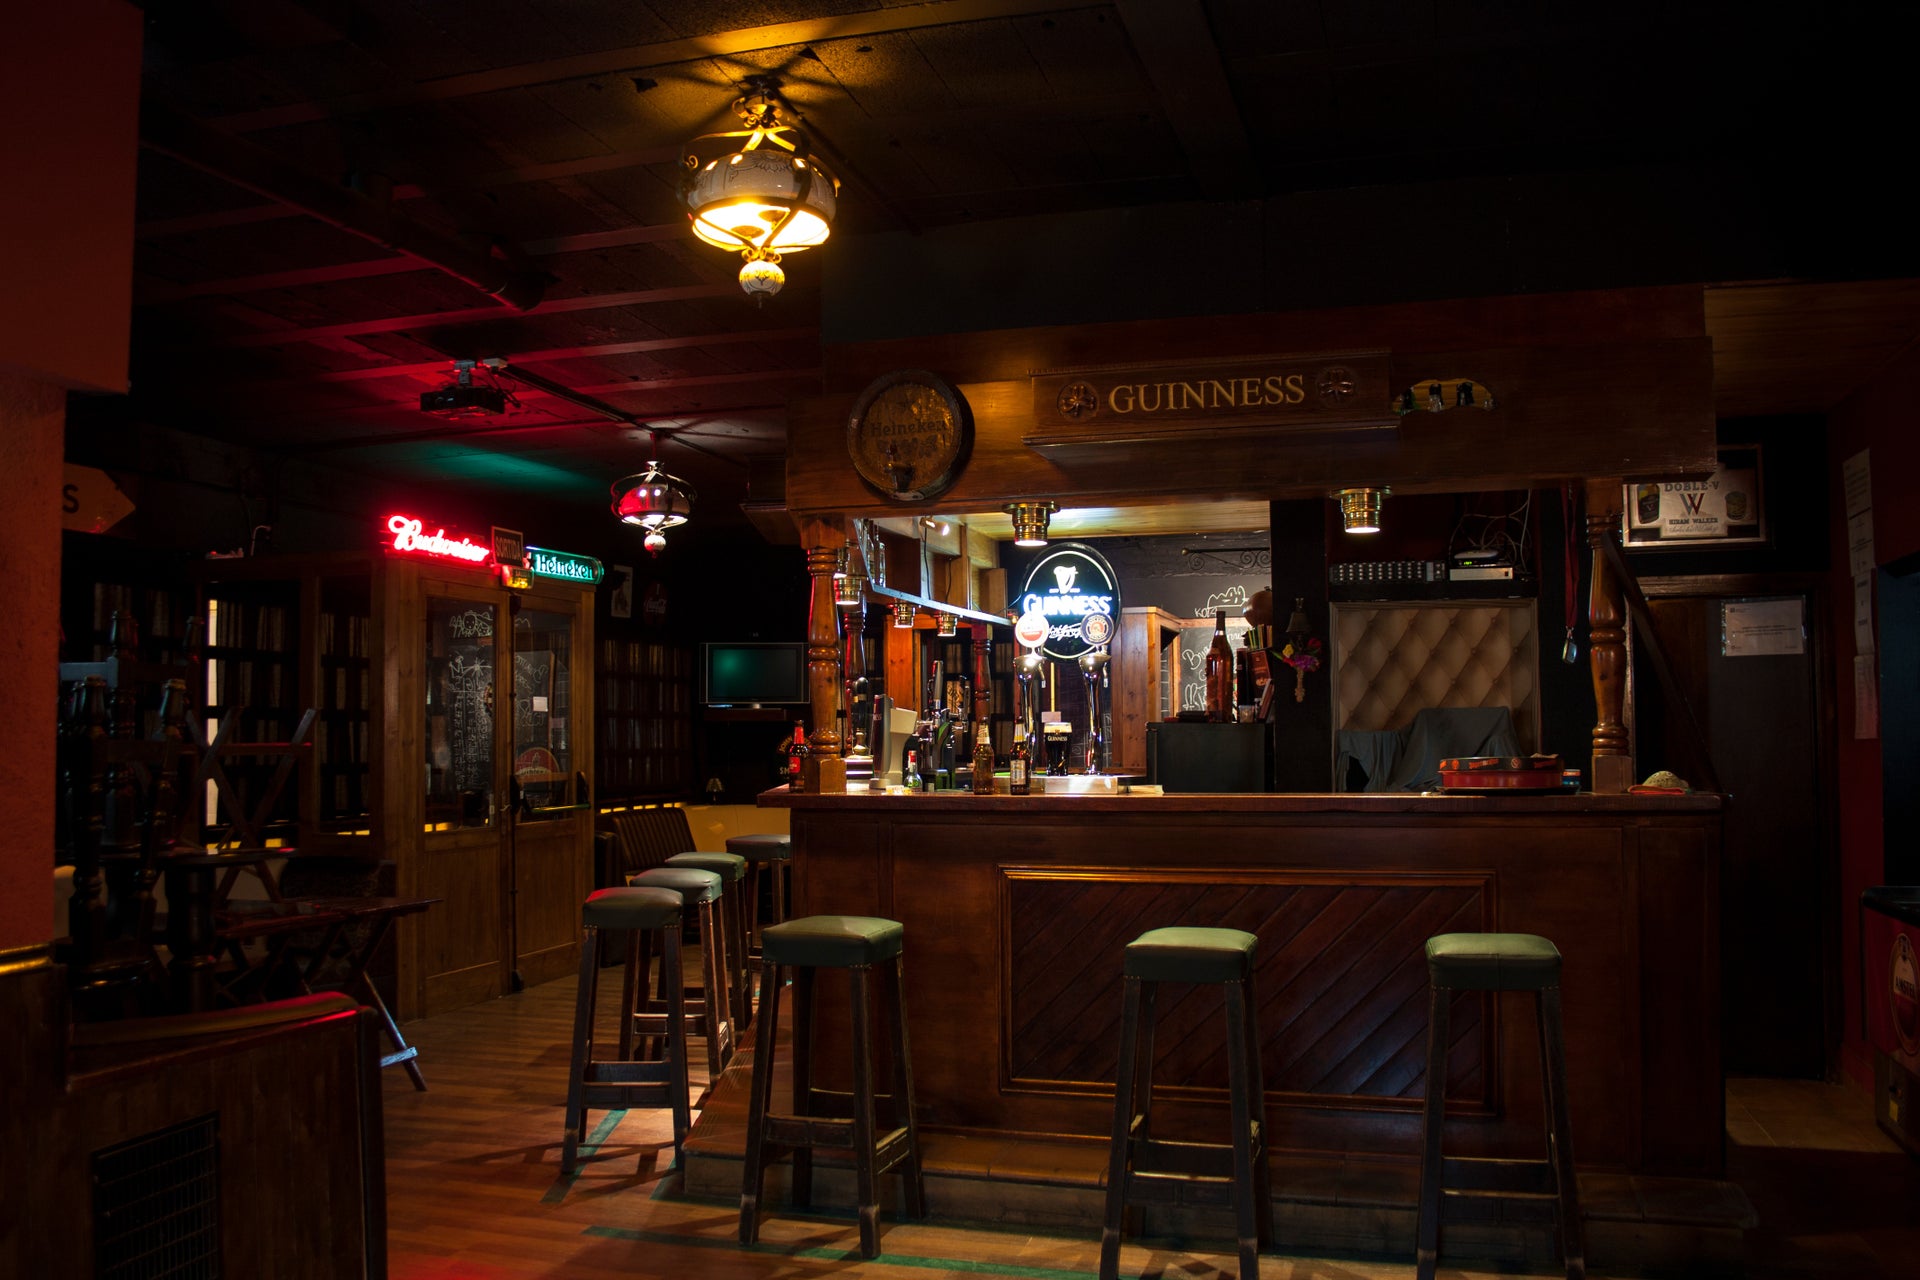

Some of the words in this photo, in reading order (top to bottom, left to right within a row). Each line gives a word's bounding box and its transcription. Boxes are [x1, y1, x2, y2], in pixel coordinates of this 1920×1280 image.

[1109, 374, 1305, 414] GUINNESS
[871, 419, 947, 437] Heineken
[388, 515, 490, 562] Budweiser
[535, 553, 595, 580] Heineken
